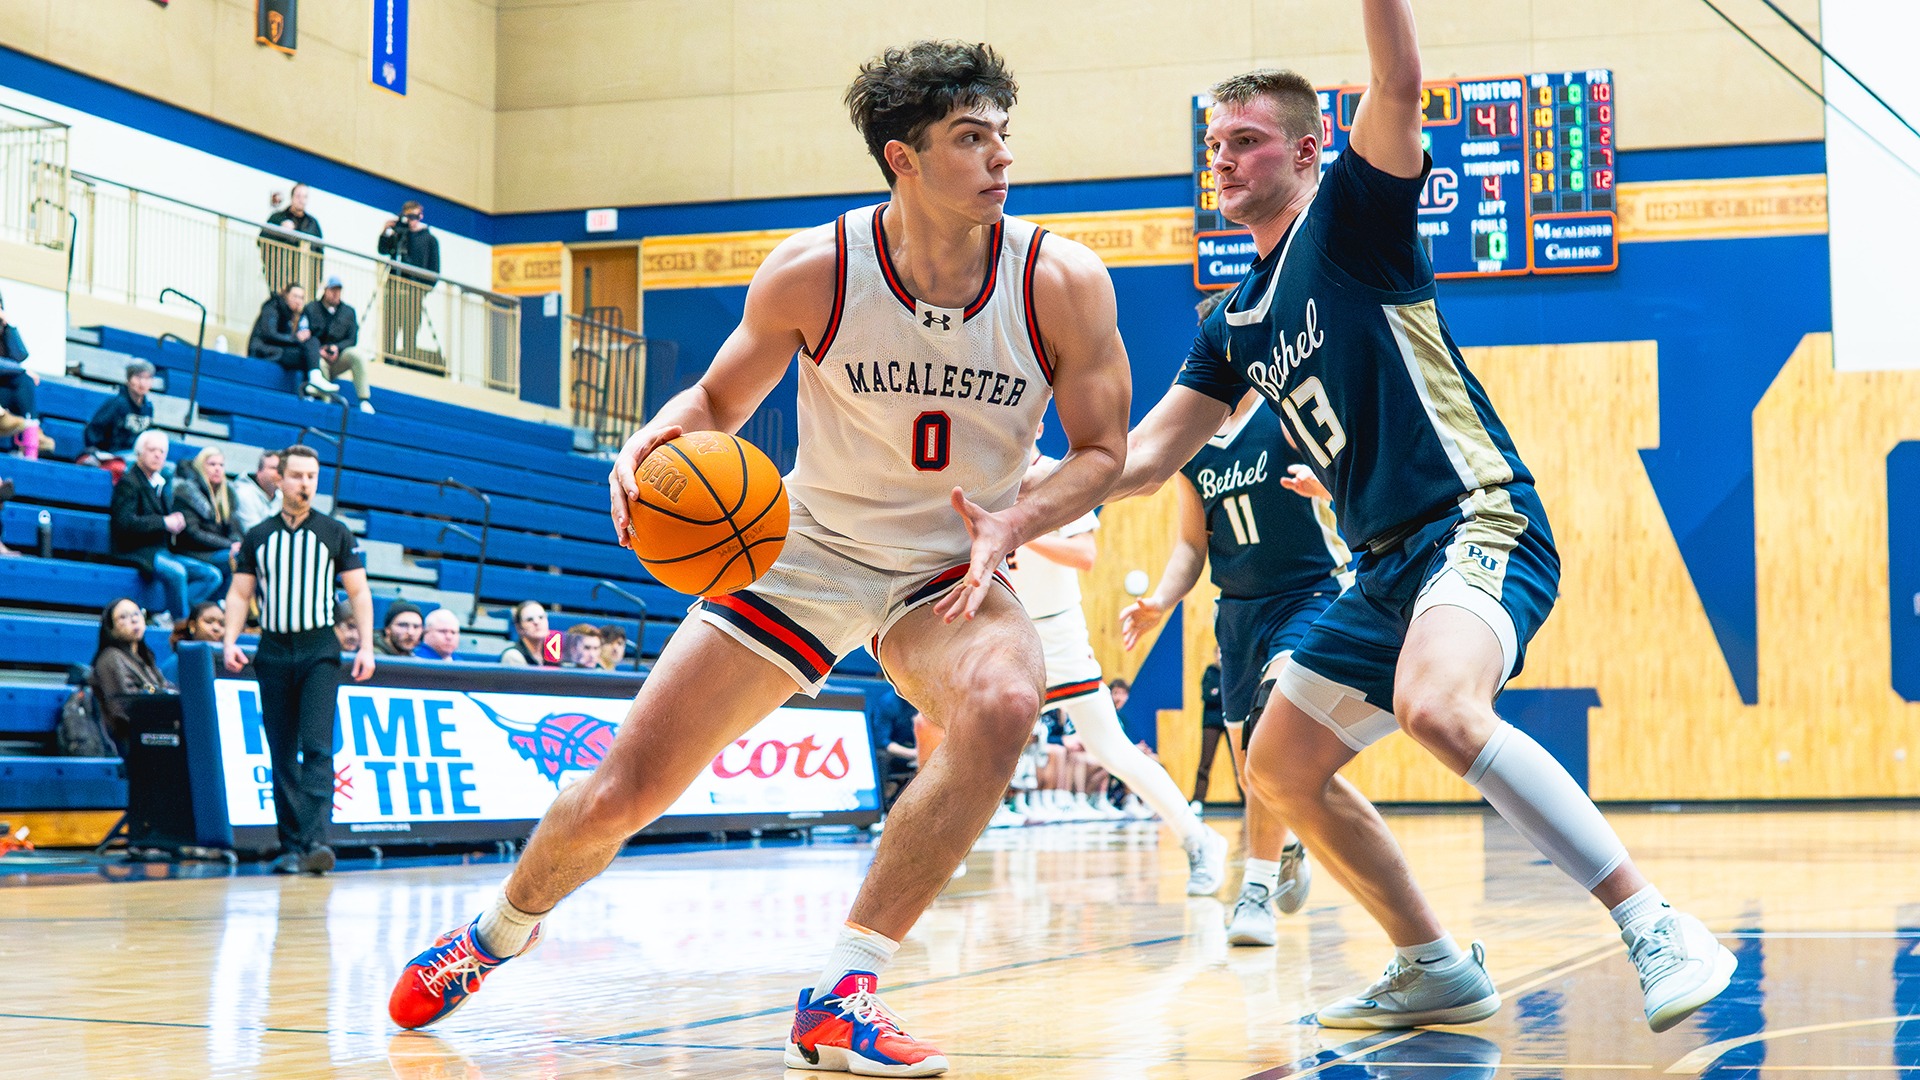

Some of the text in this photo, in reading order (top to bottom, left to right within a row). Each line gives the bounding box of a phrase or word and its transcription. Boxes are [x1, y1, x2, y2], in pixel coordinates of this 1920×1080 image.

[1461, 81, 1521, 101] VISITOR
[1592, 84, 1610, 102] 10
[1476, 102, 1517, 137] 41
[1534, 107, 1553, 128] 10
[1598, 105, 1611, 124] 0
[1535, 129, 1553, 149] 11
[1600, 126, 1612, 145] 2
[1536, 151, 1554, 171] 13
[1600, 148, 1612, 167] 7
[1483, 174, 1500, 200] 4
[1531, 173, 1554, 193] 31
[1595, 170, 1613, 189] 12
[1488, 231, 1507, 260] 0
[1247, 298, 1324, 403] Bethel
[845, 361, 1027, 407] MACALESTER
[1282, 375, 1347, 469] 13
[912, 410, 951, 472] 0
[1198, 450, 1268, 499] Bethel
[1222, 494, 1260, 545] 11
[711, 734, 850, 780] cots
[364, 761, 480, 816] THE
